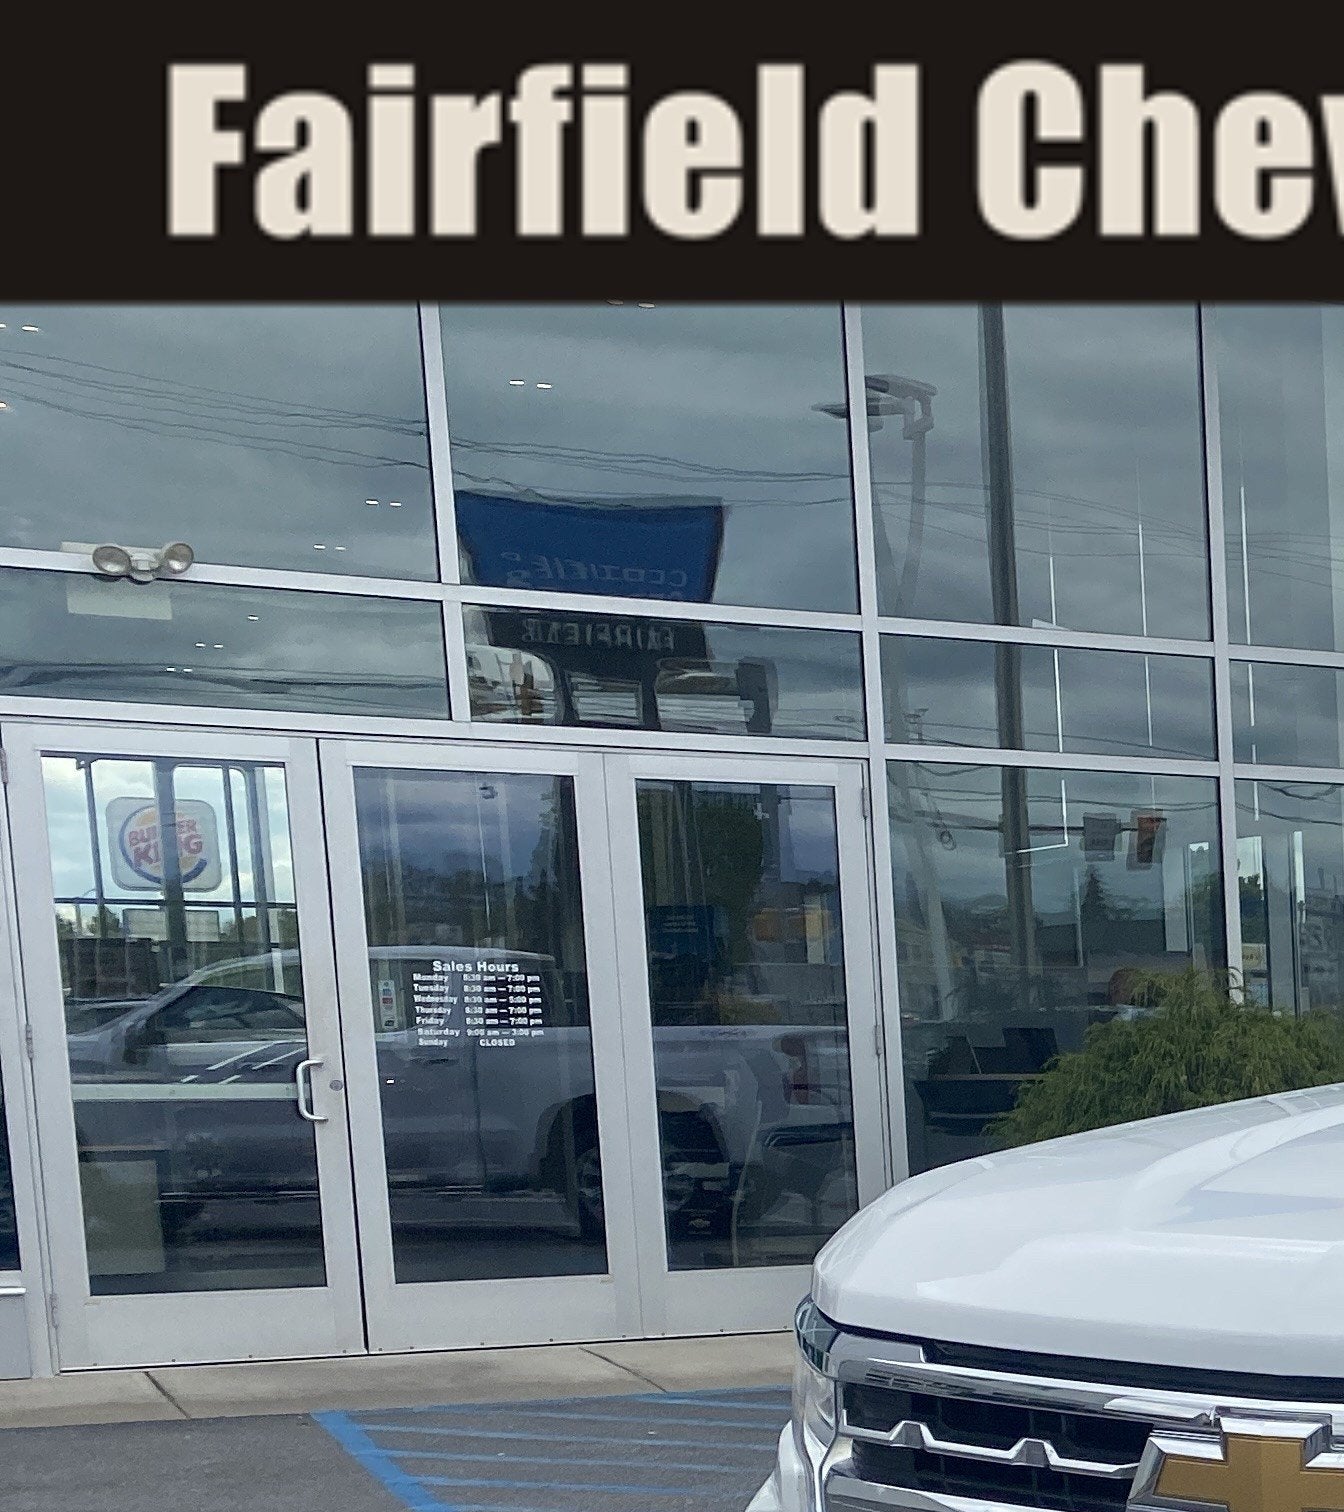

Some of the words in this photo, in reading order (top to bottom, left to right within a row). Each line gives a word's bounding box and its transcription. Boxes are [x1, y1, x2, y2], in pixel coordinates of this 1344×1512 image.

[127, 818, 198, 848] BURER
[132, 833, 203, 869] KIG
[433, 960, 473, 972] Sales
[477, 961, 519, 973] Hours
[413, 973, 449, 982] Monday
[413, 983, 449, 993] Tuesday
[415, 1006, 451, 1015] Thursday
[415, 1016, 445, 1026] Friday
[466, 1017, 484, 1025] 8:30
[417, 1028, 461, 1037] Saturday
[418, 1038, 448, 1047] Sunday
[480, 1038, 516, 1047] CLOSED
